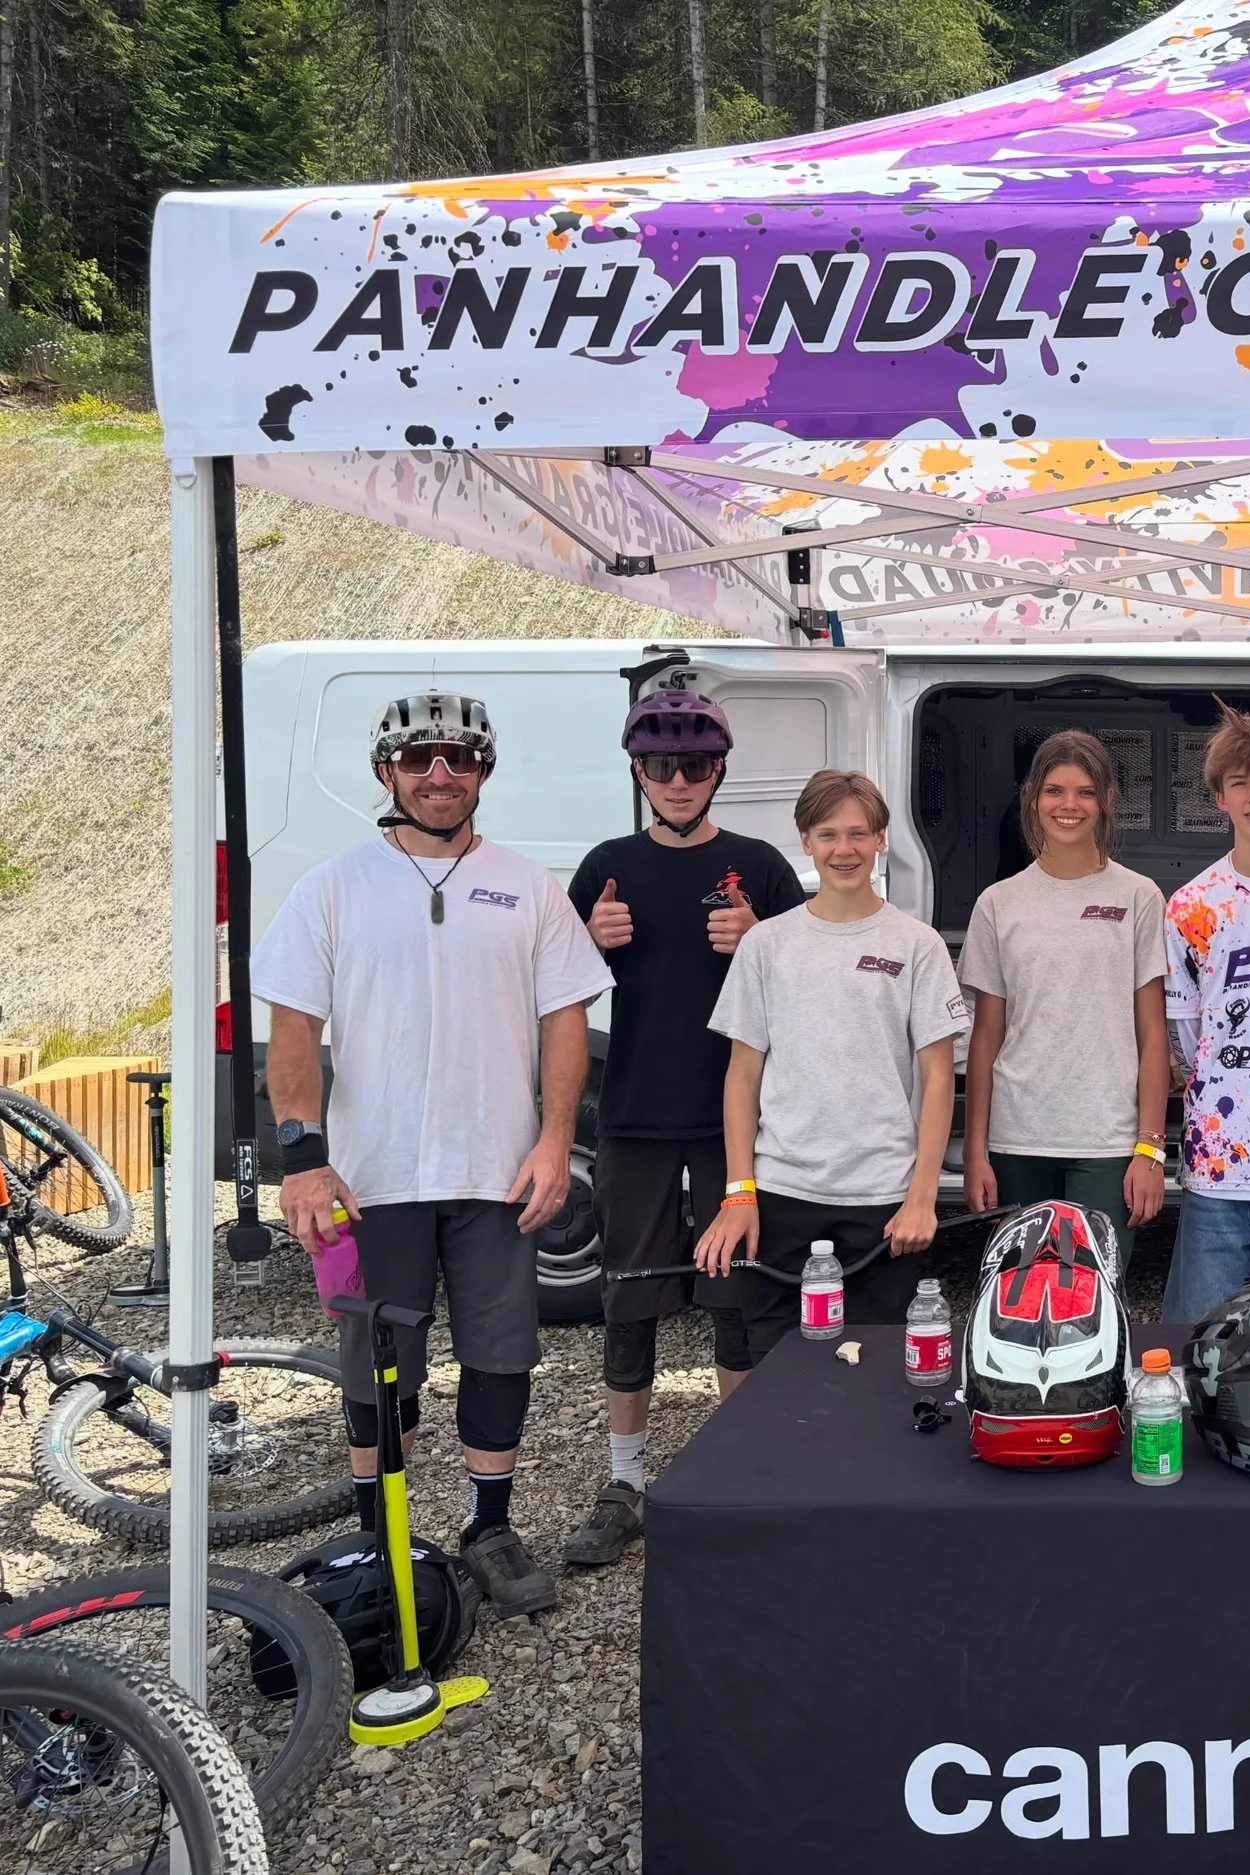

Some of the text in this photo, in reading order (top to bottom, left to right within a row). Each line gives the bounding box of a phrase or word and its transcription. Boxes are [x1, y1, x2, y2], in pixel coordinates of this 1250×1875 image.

[229, 251, 1142, 354] PANHANDLE
[469, 888, 520, 908] PGS
[243, 1145, 253, 1180] FCS
